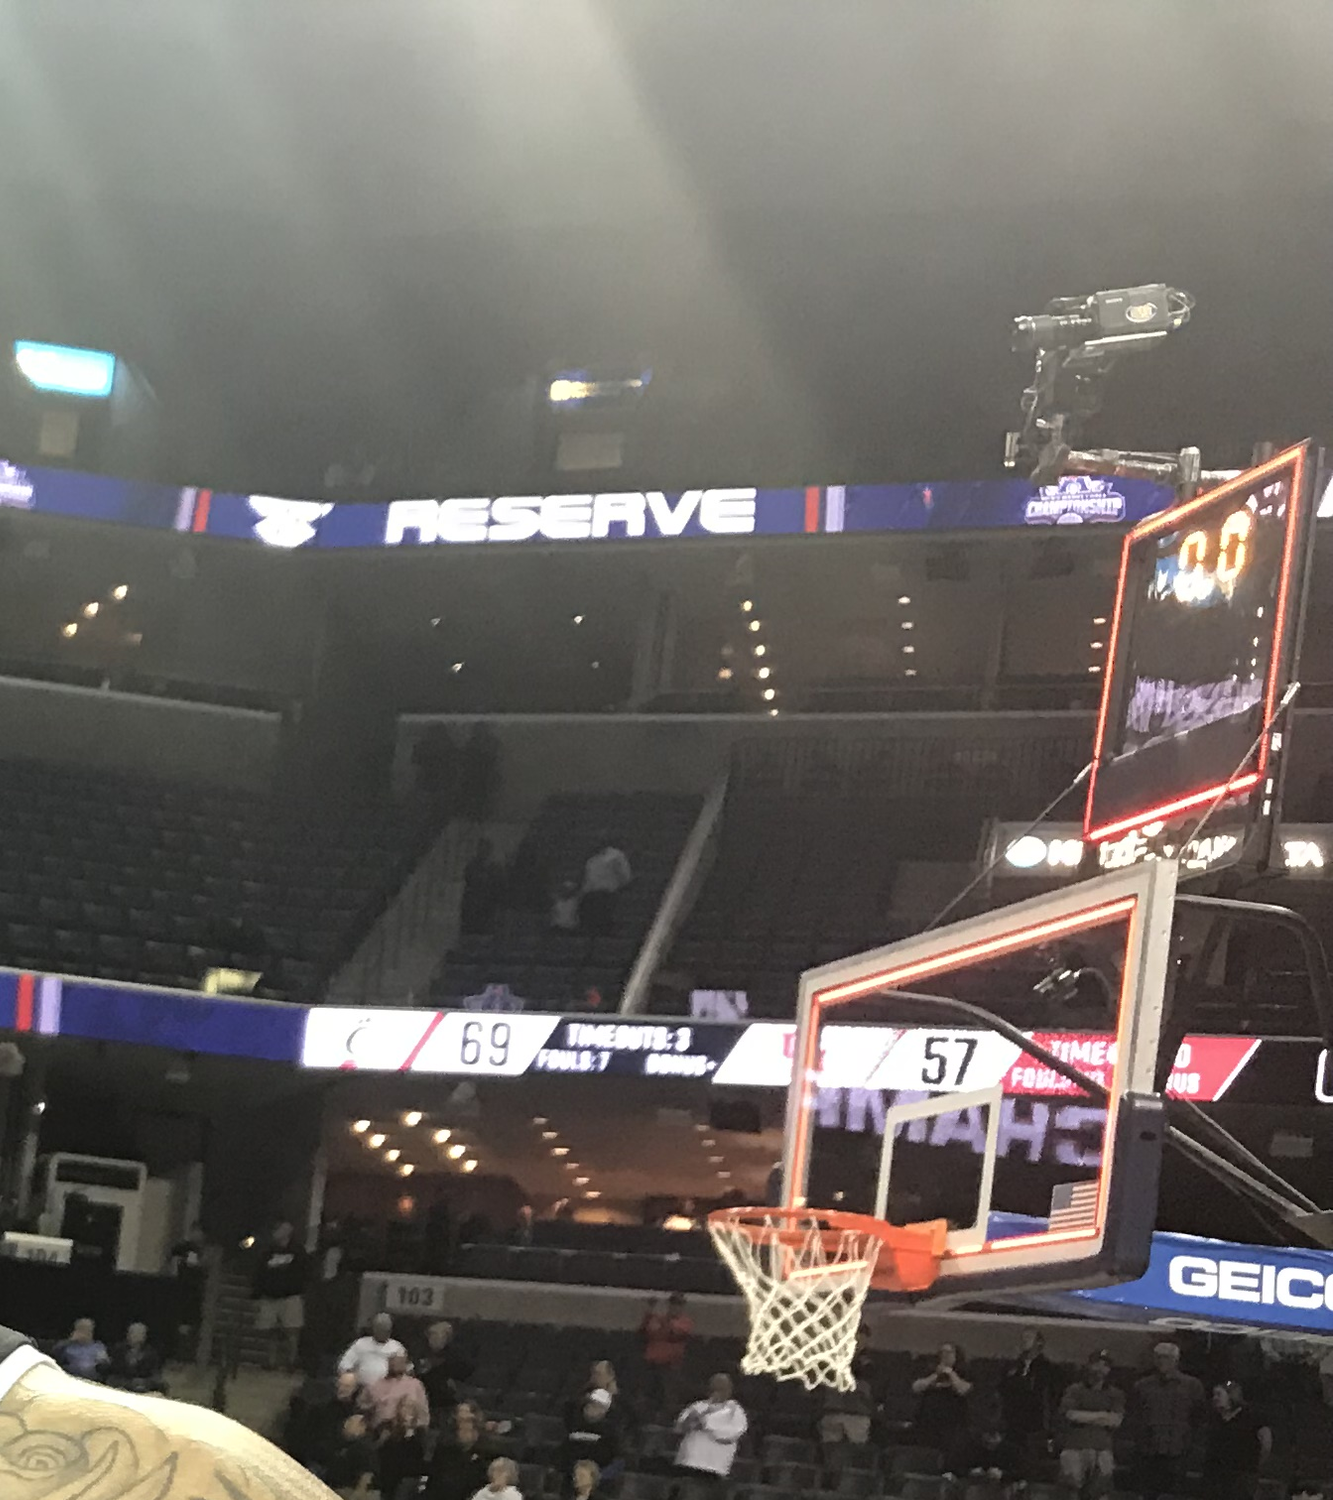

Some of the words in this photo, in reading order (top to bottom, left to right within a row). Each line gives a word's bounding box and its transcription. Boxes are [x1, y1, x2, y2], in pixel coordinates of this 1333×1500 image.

[384, 487, 757, 546] RESERVE
[460, 1021, 511, 1067] 69
[921, 1036, 978, 1085] 57
[1169, 1255, 1333, 1313] GEIC
